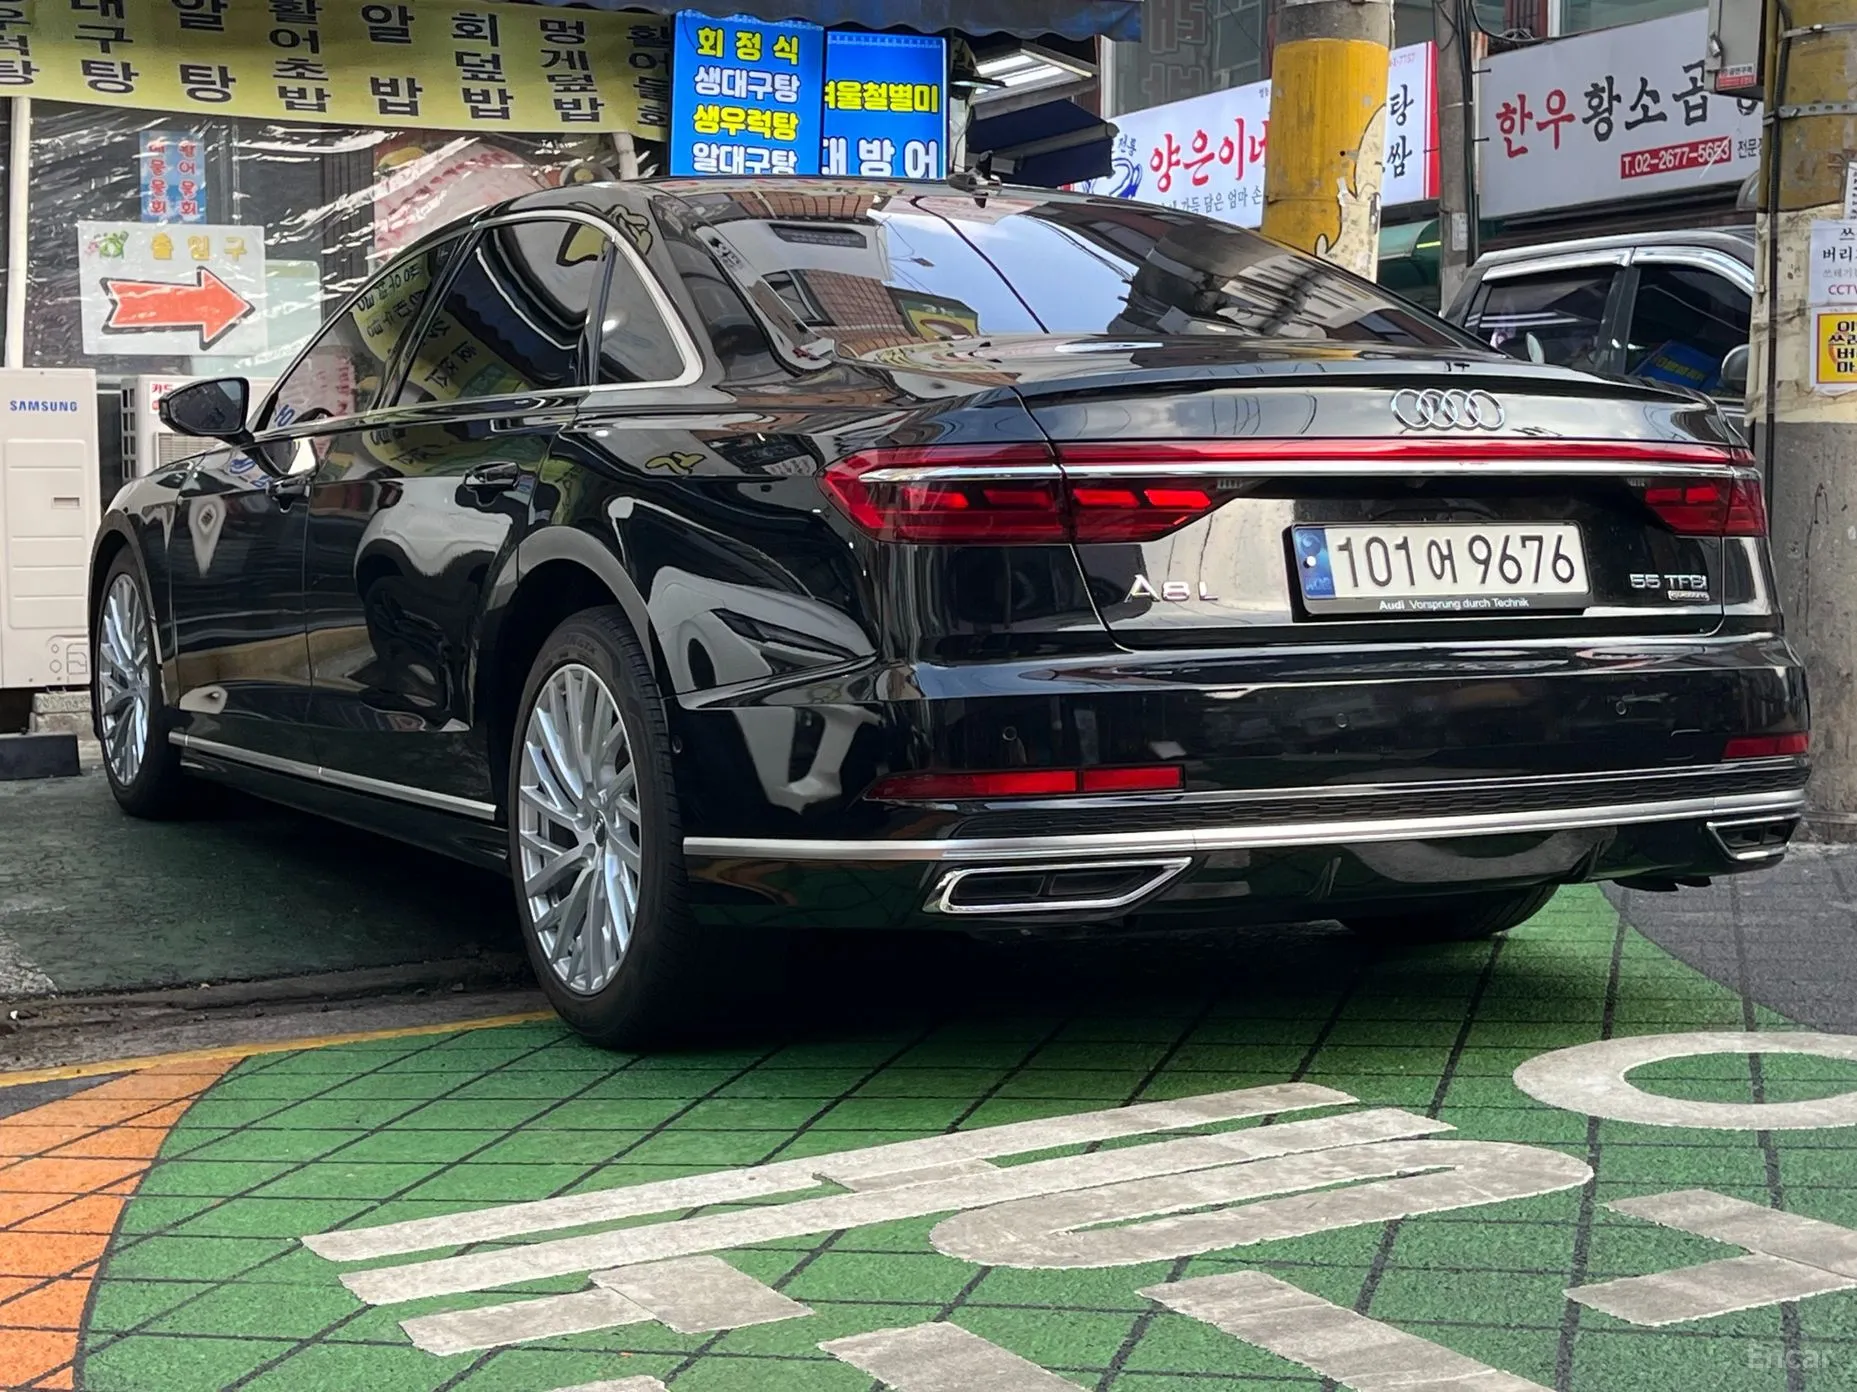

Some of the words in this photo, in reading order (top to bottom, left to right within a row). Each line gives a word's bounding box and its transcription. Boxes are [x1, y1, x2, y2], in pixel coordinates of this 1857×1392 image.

[361, 4, 424, 116] 알밥
[451, 12, 514, 120] 회덮밥
[539, 18, 605, 123] 멍게덮밥
[694, 66, 801, 103] 생대구탕
[693, 104, 799, 141] 생우럭탕
[692, 142, 799, 175] 알대구탕
[1823, 246, 1857, 263] 버리
[9, 400, 78, 412] SAMSUNG
[1337, 535, 1458, 588] 101어
[1467, 534, 1575, 585] 9676
[1629, 573, 1661, 588] 55
[1379, 599, 1405, 610] Audi
[1408, 599, 1462, 611] Vorsprung
[1463, 598, 1491, 608] durch
[1492, 597, 1530, 608] Technik
